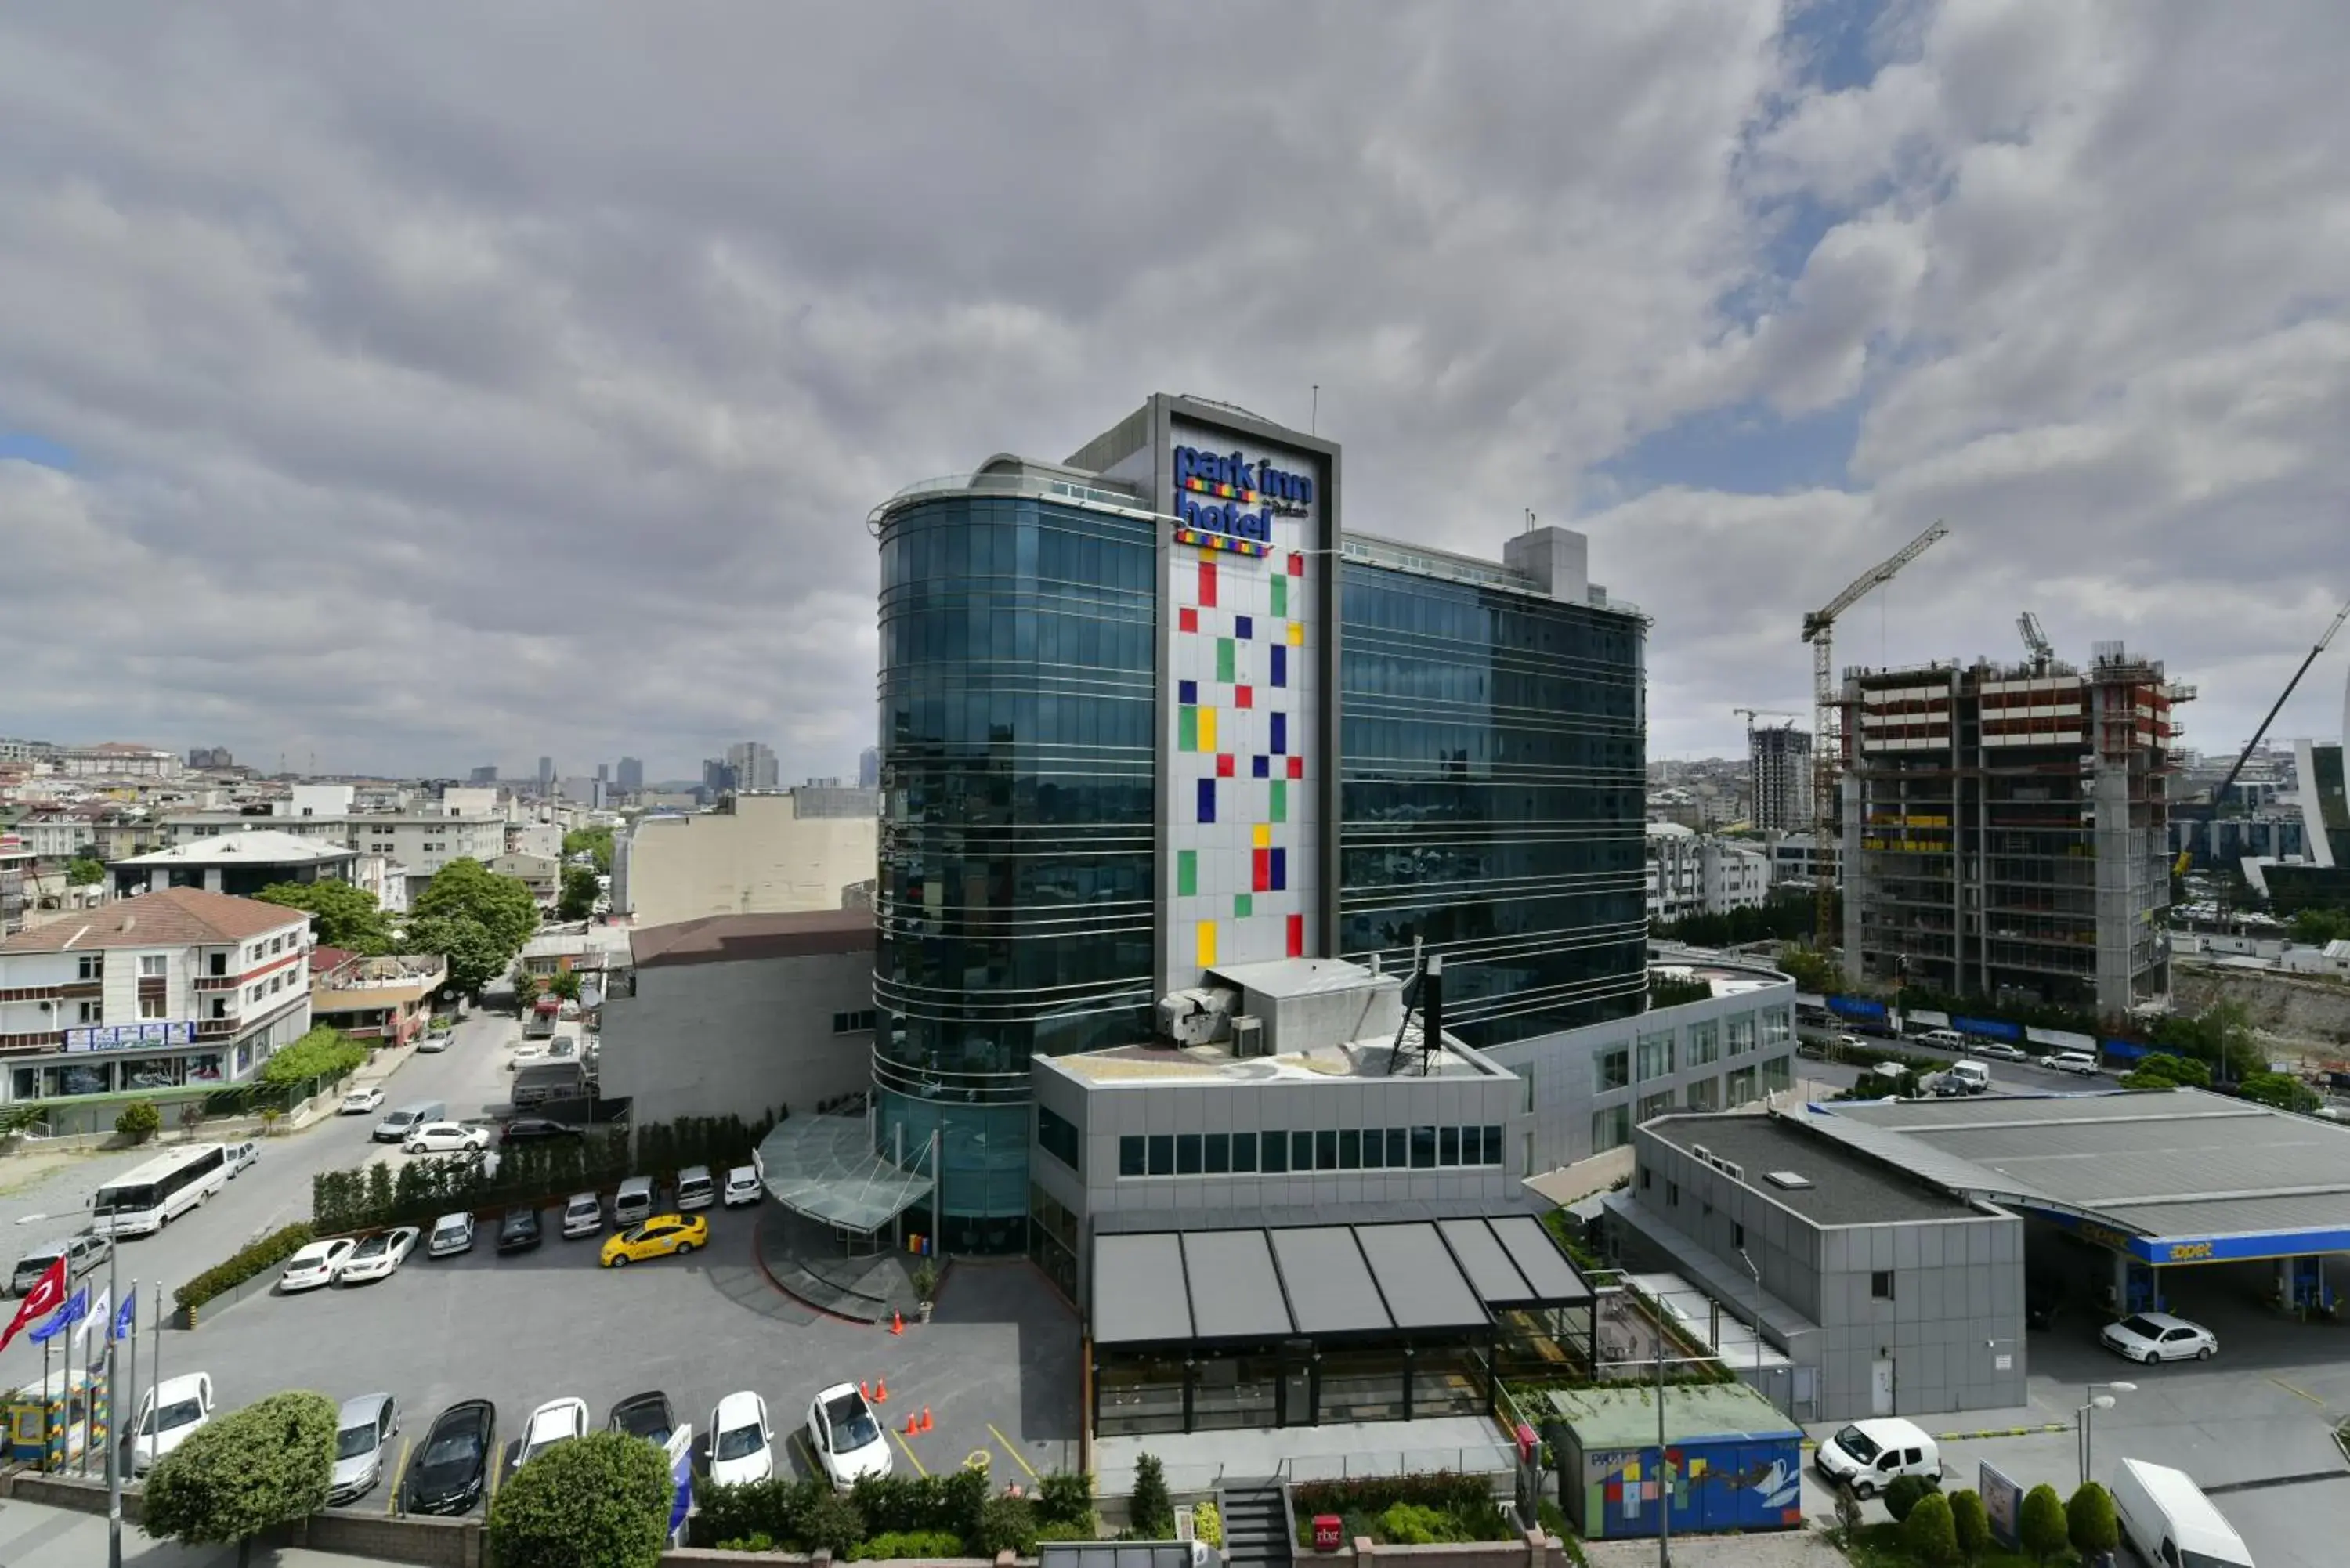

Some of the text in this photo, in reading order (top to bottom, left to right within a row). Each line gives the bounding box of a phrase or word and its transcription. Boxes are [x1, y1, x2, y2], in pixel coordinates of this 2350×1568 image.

[1174, 445, 1313, 505] park inn
[1176, 487, 1271, 543] hotel
